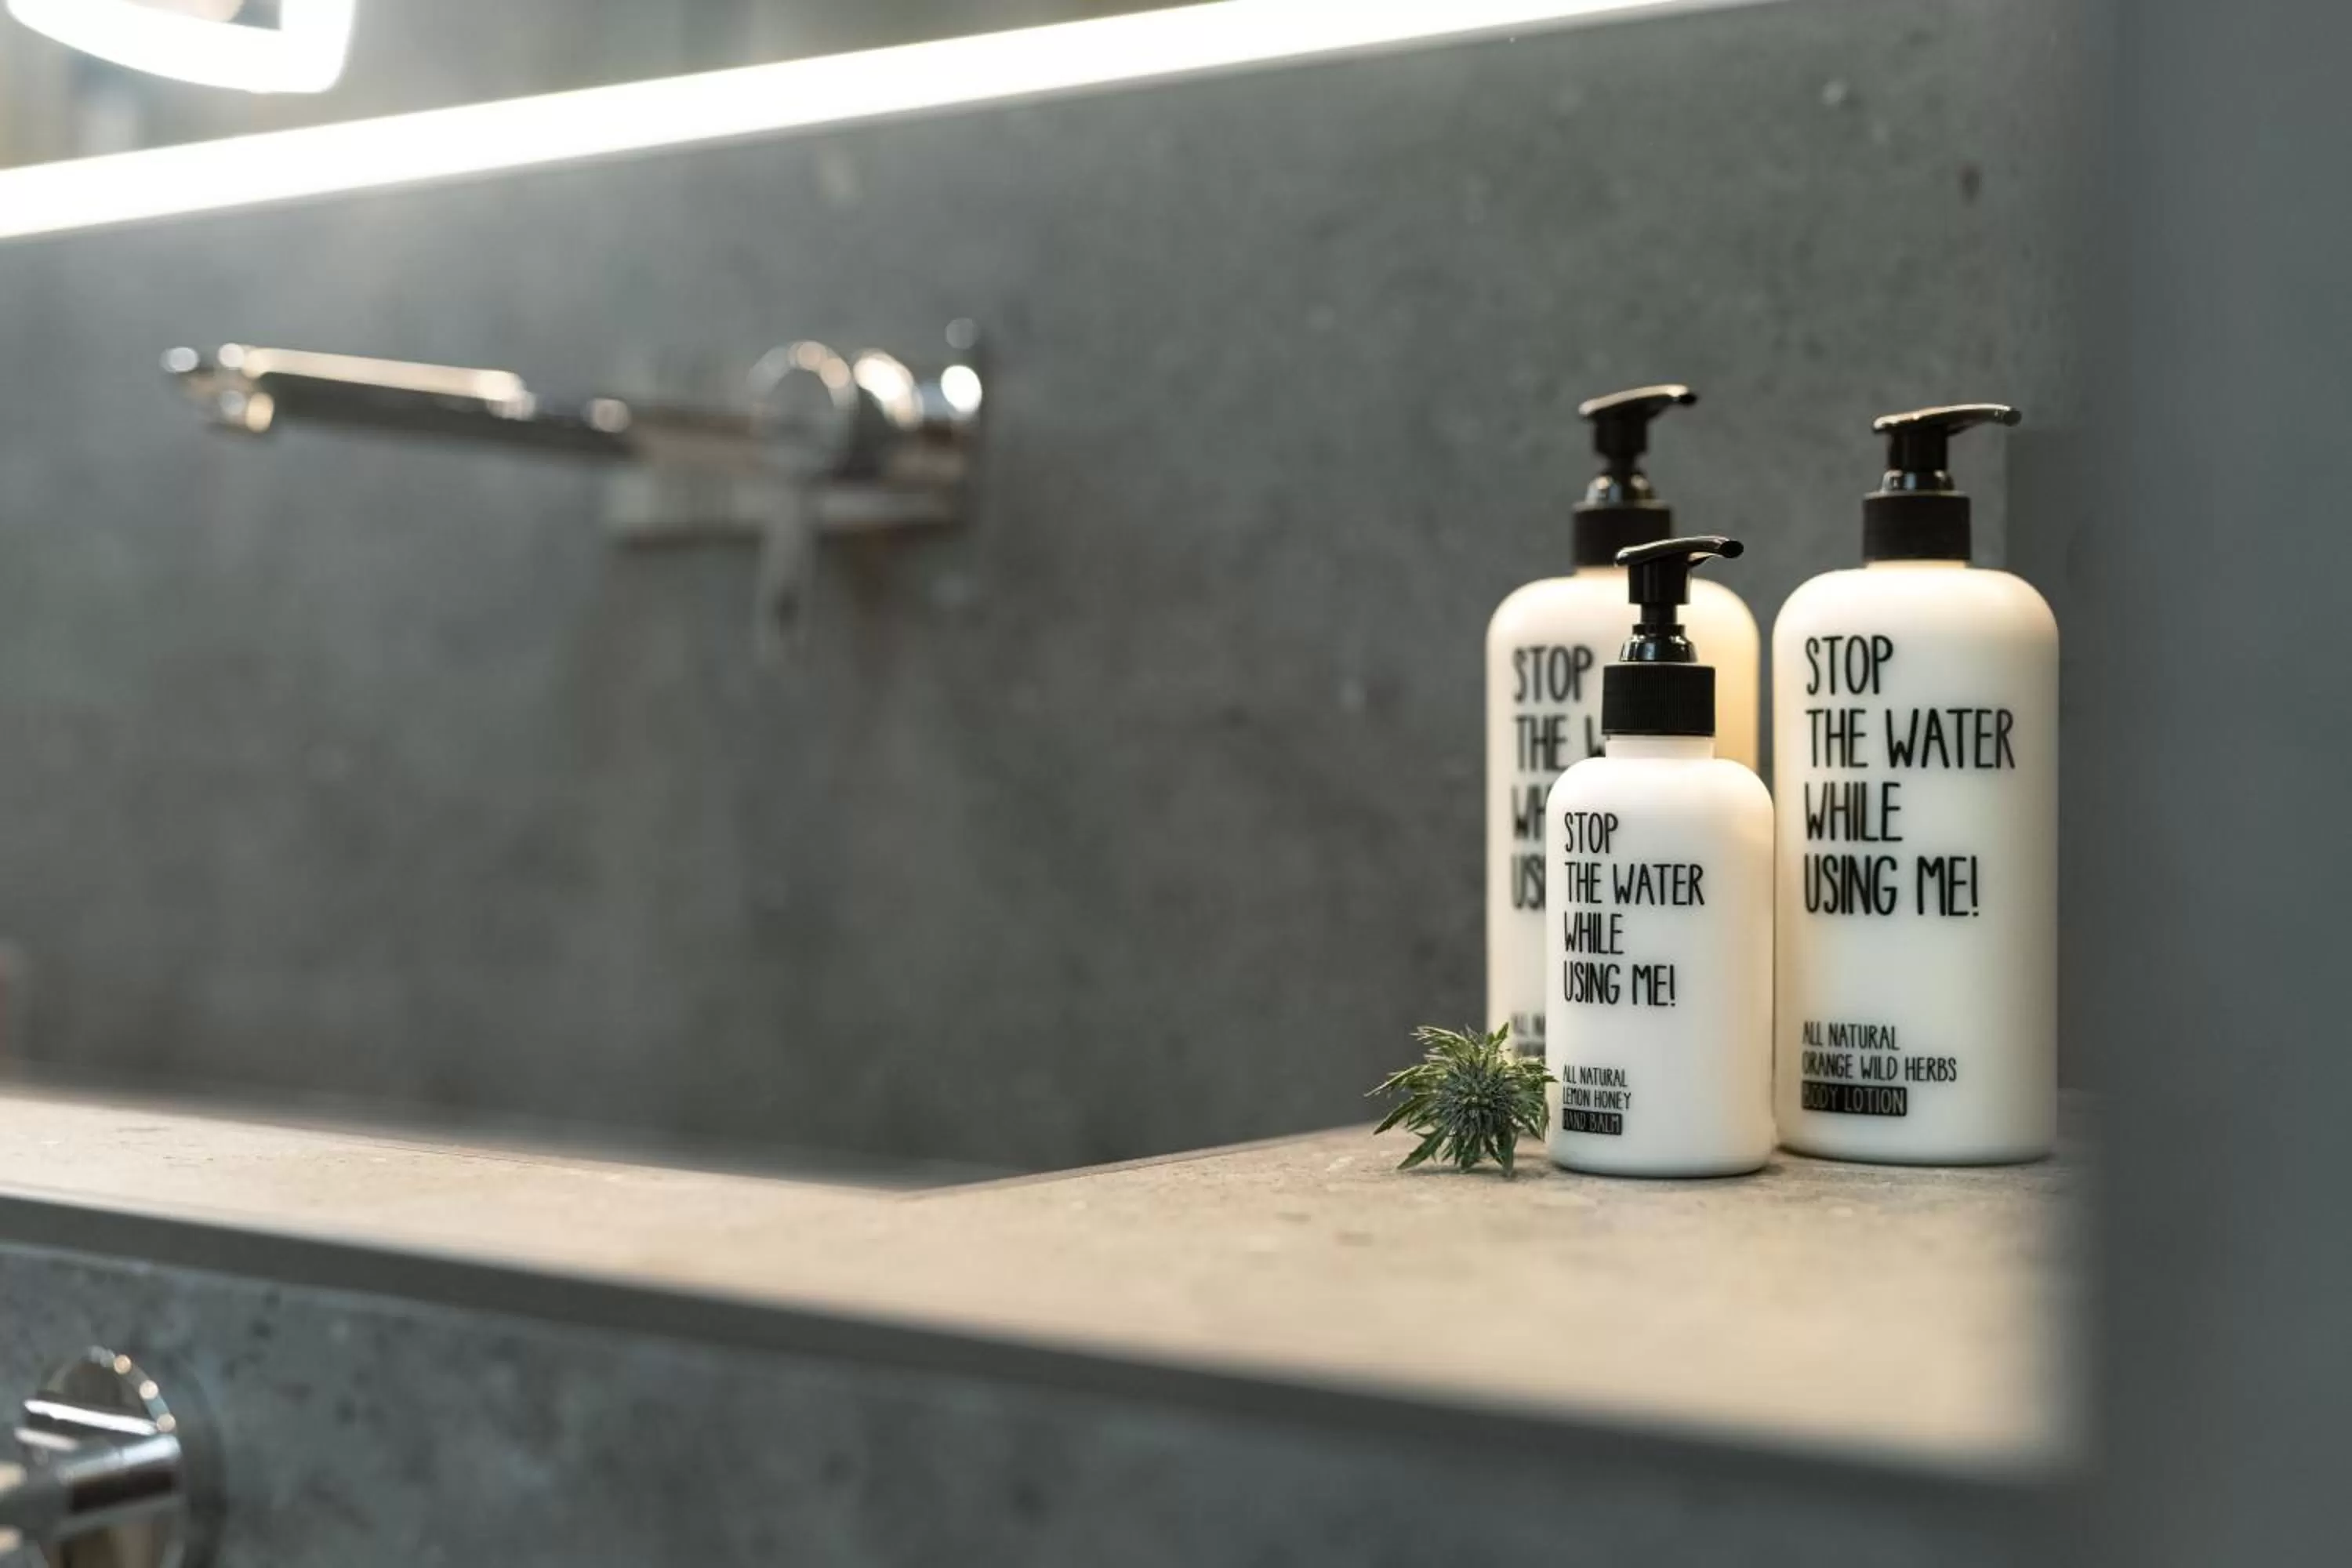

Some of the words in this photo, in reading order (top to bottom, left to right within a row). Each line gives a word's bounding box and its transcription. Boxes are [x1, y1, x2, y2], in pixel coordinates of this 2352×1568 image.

[1512, 644, 1594, 703] STOP
[1806, 634, 1894, 695] STOP
[1513, 714, 1568, 771] THE
[1806, 708, 1869, 768] THE
[1886, 708, 2016, 769] WATER
[1564, 812, 1619, 854] STOP
[1805, 782, 1904, 842] WHILE
[1565, 862, 1602, 904] THE
[1613, 863, 1705, 906] WATER
[1804, 853, 1898, 916] USING
[1916, 855, 1980, 917] ME!
[1563, 911, 1624, 955] WHILE
[1563, 960, 1621, 1005] USING
[1632, 964, 1676, 1007] ME!
[1802, 1020, 1824, 1047] ALL
[1828, 1022, 1901, 1051] NATURAL
[1563, 1064, 1577, 1084] ALL
[1580, 1065, 1628, 1087] NATURAL
[1802, 1051, 1854, 1080] ORANGE
[1860, 1055, 1899, 1081] WILD
[1904, 1056, 1958, 1083] HERBS
[1563, 1086, 1591, 1107] LEMON
[1594, 1090, 1632, 1110] HONEY
[1843, 1087, 1906, 1115] LOTION
[1589, 1112, 1621, 1134] BALM
